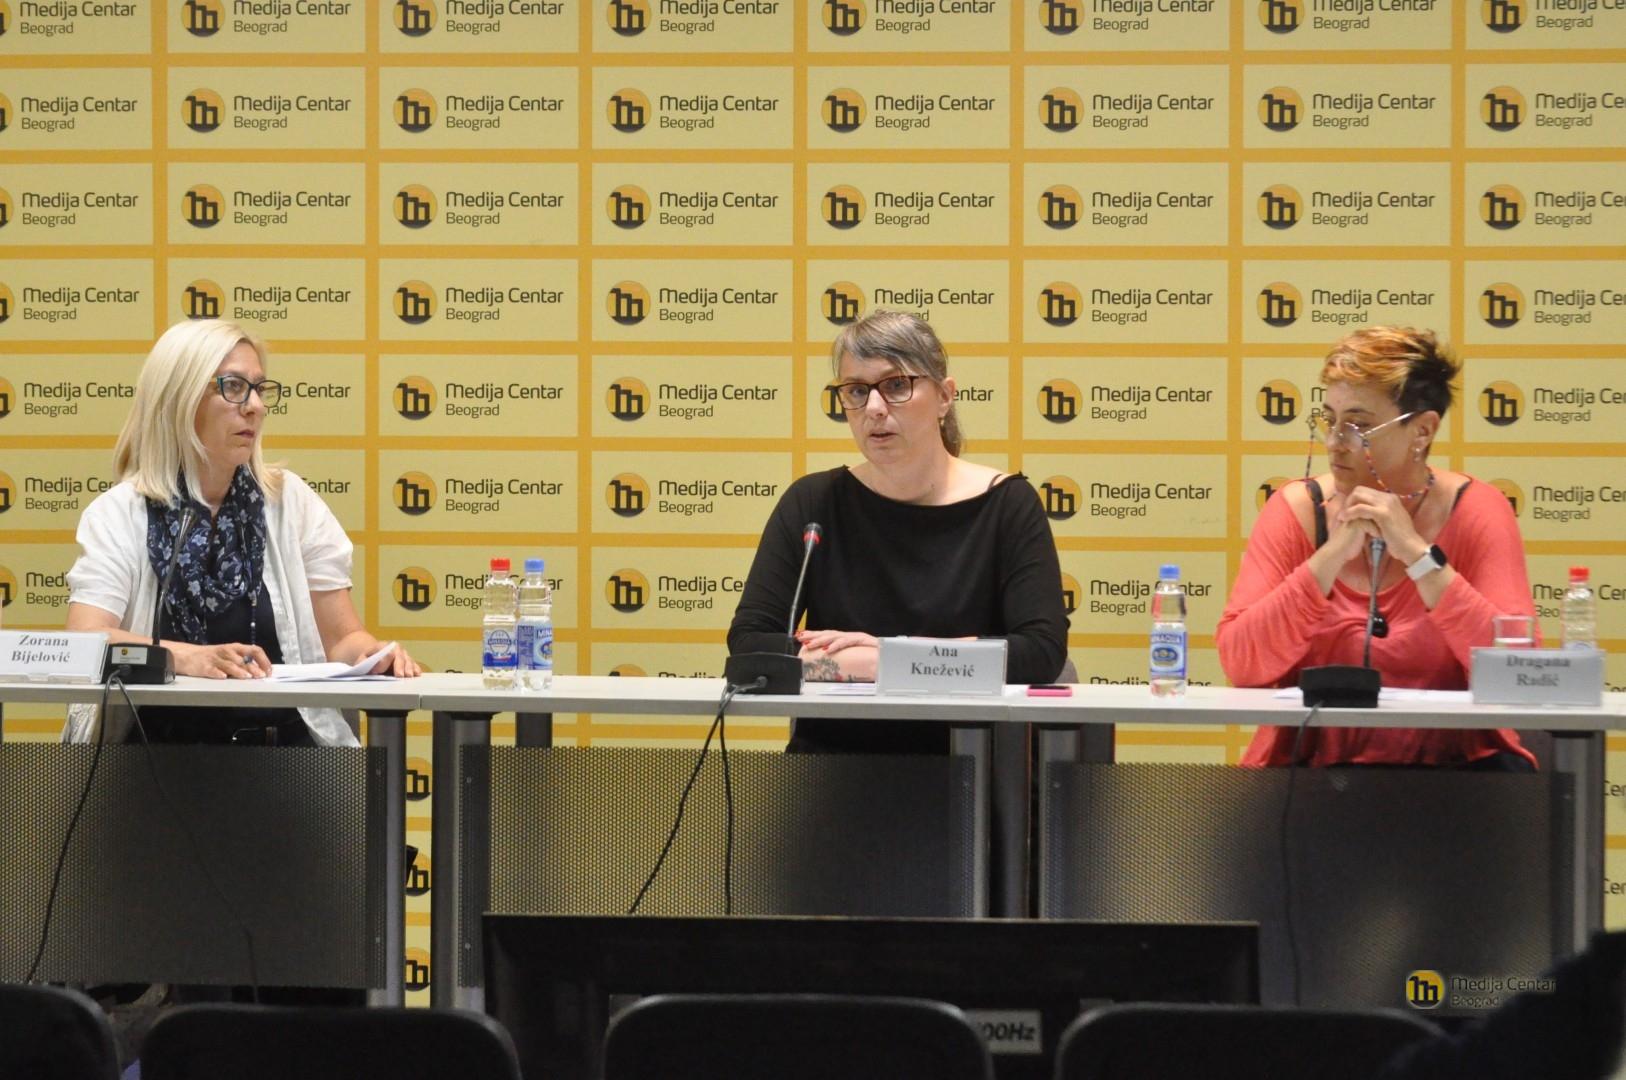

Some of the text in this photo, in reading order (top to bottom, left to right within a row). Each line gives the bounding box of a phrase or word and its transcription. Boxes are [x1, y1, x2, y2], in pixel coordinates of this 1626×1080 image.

[20, 1, 136, 20] Medija Centar
[234, 0, 351, 19] Medija Centar
[446, 0, 564, 19] Medija Centar
[660, 0, 779, 18] Medija Centar
[876, 0, 996, 17] Medija Centar
[1094, 0, 1215, 16] Medija Centar
[1314, 0, 1437, 15] Medija Centar
[1536, 0, 1597, 14] Medija
[20, 22, 73, 37] Beograd
[234, 21, 288, 35] Beograd
[446, 20, 500, 35] Beograd
[660, 20, 714, 34] Beograd
[876, 19, 930, 34] Beograd
[1093, 18, 1149, 33] Beograd
[1313, 17, 1370, 32] Beograd
[1536, 16, 1593, 30] Beograd
[21, 97, 137, 116] Medija Centar
[234, 96, 351, 115] Medija Centar
[446, 96, 564, 115] Medija Centar
[660, 95, 779, 114] Medija Centar
[876, 95, 995, 114] Medija Centar
[1093, 94, 1214, 114] Medija Centar
[1313, 93, 1436, 113] Medija Centar
[1536, 93, 1596, 112] Medija
[21, 117, 74, 132] Beograd
[234, 116, 288, 131] Beograd
[446, 116, 500, 131] Beograd
[660, 116, 714, 131] Beograd
[876, 116, 930, 131] Beograd
[1093, 115, 1148, 130] Beograd
[1312, 115, 1369, 130] Beograd
[1536, 114, 1592, 129] Beograd
[22, 192, 138, 211] Medija Centar
[234, 191, 351, 210] Medija Centar
[446, 192, 564, 211] Medija Centar
[660, 192, 778, 211] Medija Centar
[875, 192, 995, 211] Medija Centar
[1093, 192, 1214, 211] Medija Centar
[1313, 192, 1435, 211] Medija Centar
[1535, 192, 1596, 211] Medija
[22, 213, 75, 227] Beograd
[234, 212, 288, 227] Beograd
[446, 212, 500, 227] Beograd
[660, 213, 713, 227] Beograd
[875, 213, 929, 228] Beograd
[1092, 213, 1148, 228] Beograd
[1312, 213, 1369, 228] Beograd
[1535, 213, 1592, 228] Beograd
[23, 287, 139, 306] Medija Centar
[234, 287, 351, 306] Medija Centar
[446, 287, 564, 307] Medija Centar
[660, 288, 778, 307] Medija Centar
[875, 289, 994, 308] Medija Centar
[1092, 289, 1214, 308] Medija Centar
[1312, 289, 1434, 309] Medija Centar
[1534, 290, 1596, 309] Medija
[23, 308, 76, 323] Beograd
[234, 308, 288, 322] Beograd
[446, 308, 500, 323] Beograd
[660, 309, 713, 324] Beograd
[1092, 310, 1148, 325] Beograd
[1312, 310, 1368, 325] Beograd
[1534, 311, 1592, 326] Beograd
[24, 382, 81, 401] Medija
[296, 382, 351, 398] Centar
[446, 383, 563, 402] Medija Centar
[659, 384, 778, 404] Medija Centar
[1092, 386, 1213, 405] Medija Centar
[1534, 388, 1595, 407] Medija
[24, 403, 77, 417] Beograd
[446, 404, 499, 419] Beograd
[659, 405, 713, 420] Beograd
[1092, 407, 1147, 422] Beograd
[1534, 409, 1591, 424] Beograd
[25, 477, 82, 496] Medija
[446, 479, 563, 498] Medija Centar
[659, 480, 777, 499] Medija Centar
[1091, 483, 1212, 502] Medija Centar
[1534, 486, 1594, 506] Medija
[25, 498, 78, 512] Beograd
[446, 499, 499, 514] Beograd
[659, 501, 712, 516] Beograd
[1091, 504, 1146, 519] Beograd
[1534, 507, 1590, 522] Beograd
[659, 576, 716, 595] Medija
[1091, 580, 1150, 599] Medija
[659, 597, 712, 612] Beograd
[1091, 601, 1146, 616] Beograd
[19, 635, 69, 647] Zorana
[11, 651, 70, 664] Bijelović
[929, 645, 958, 657] Ana
[911, 662, 975, 677] Knežević
[1506, 655, 1570, 669] Dragana
